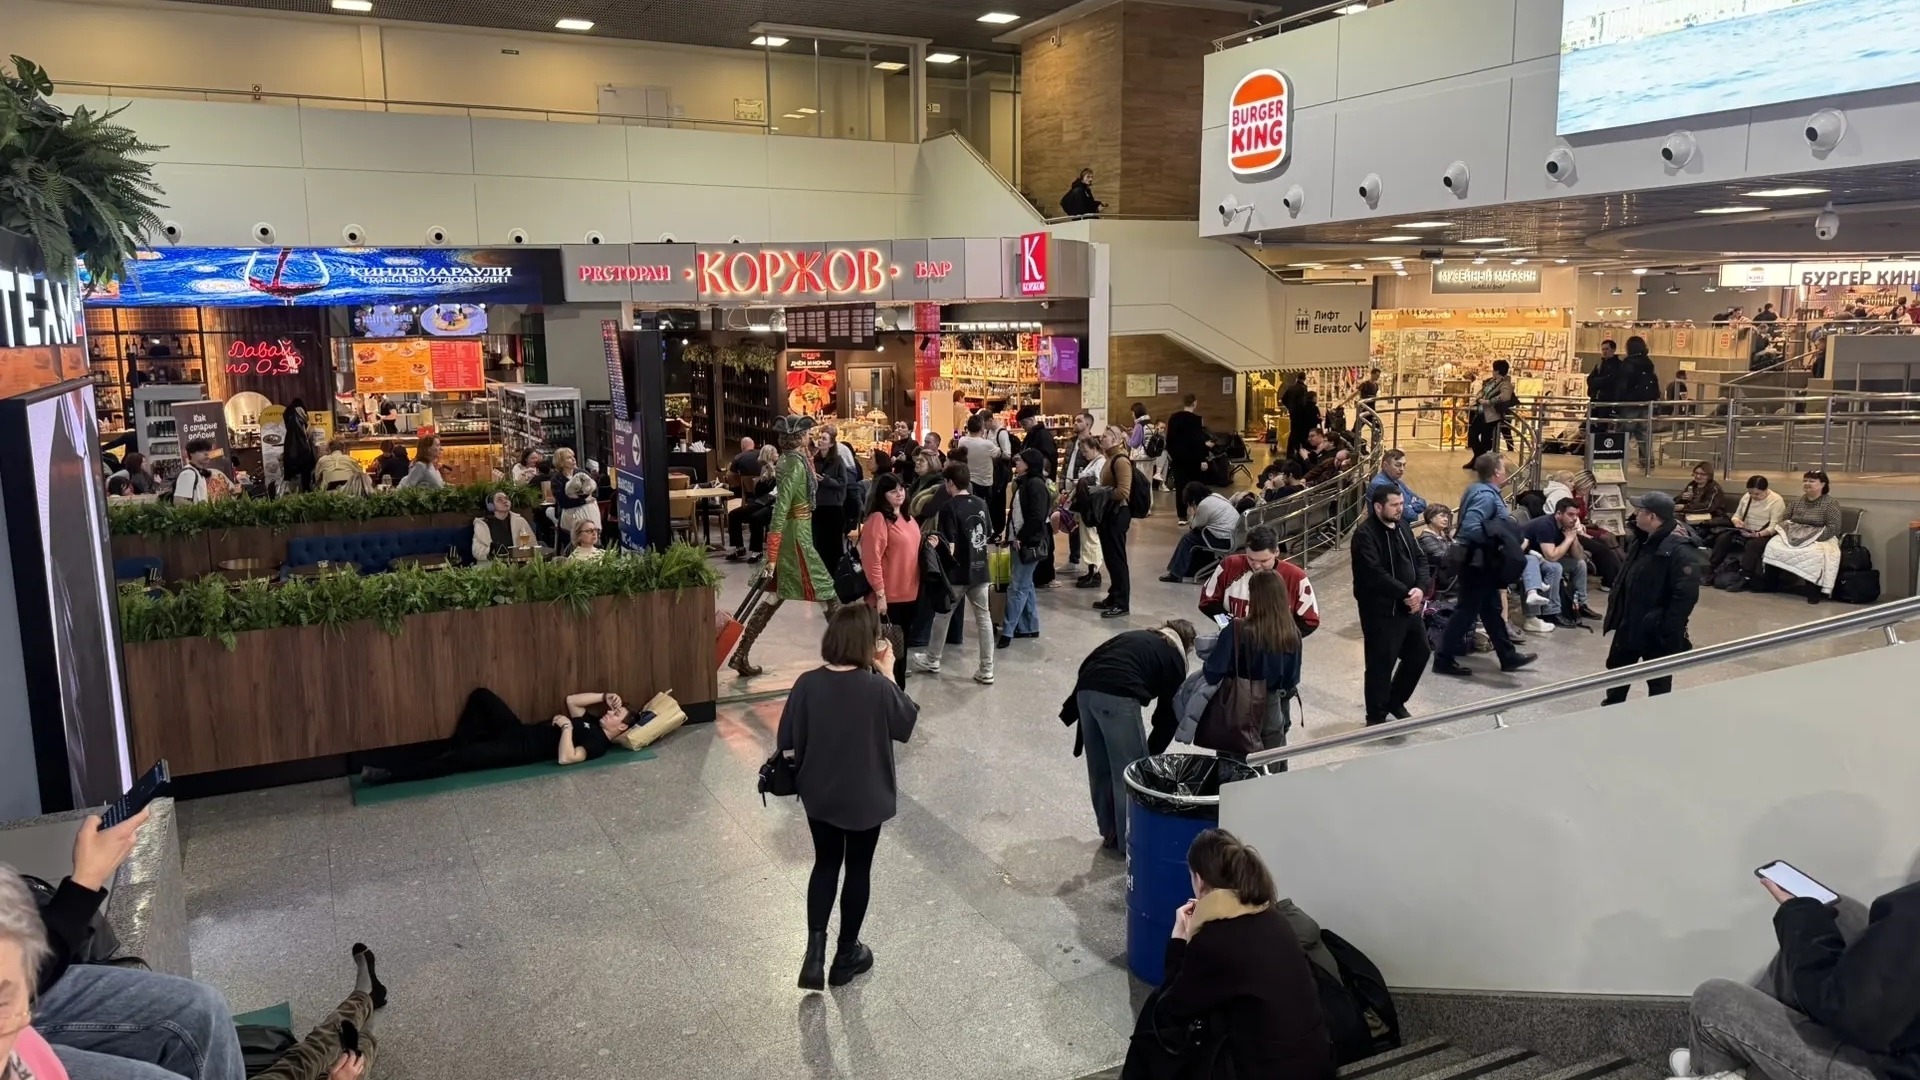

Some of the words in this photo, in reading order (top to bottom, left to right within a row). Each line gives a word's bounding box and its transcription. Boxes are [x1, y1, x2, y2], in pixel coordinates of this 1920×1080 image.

[1232, 99, 1283, 126] BURGER
[1231, 120, 1283, 154] KING
[1024, 236, 1043, 280] К
[349, 266, 513, 276] КИНДЗМАРАУЛИ
[579, 264, 671, 283] РЕСТОРАН
[697, 248, 885, 295] КОРЖОВ
[914, 261, 953, 279] БАР
[1439, 268, 1492, 282] МУЗЕЙНЫЙ
[1495, 269, 1537, 282] МАГАЗИН
[426, 276, 503, 284] ОТДОХНУЛИ
[1801, 271, 1872, 285] БУРГЕР
[1314, 310, 1340, 321] Лифт
[1314, 324, 1352, 333] Elevator
[228, 339, 297, 358] Давай
[192, 413, 207, 423] Как
[189, 422, 218, 432] старые
